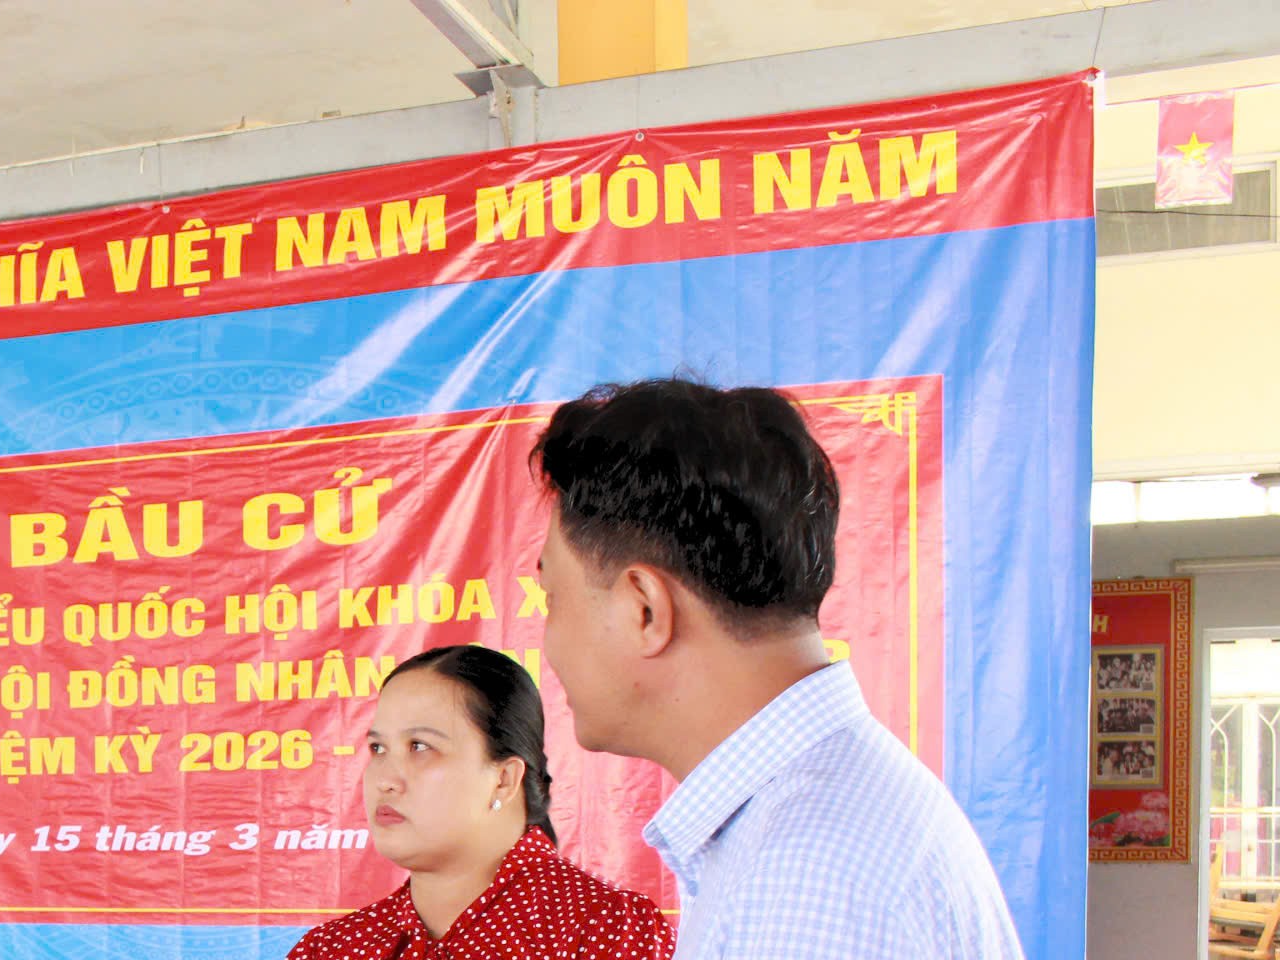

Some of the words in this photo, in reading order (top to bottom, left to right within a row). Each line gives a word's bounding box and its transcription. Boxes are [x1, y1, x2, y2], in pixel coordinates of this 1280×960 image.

[106, 218, 253, 297] VIỆT
[275, 194, 447, 272] NAM
[475, 154, 721, 243] MUÔN
[752, 128, 958, 215] NĂM
[10, 486, 204, 568] BẦU
[242, 466, 394, 551] CỬ
[62, 585, 206, 648] QUỐC
[224, 583, 318, 641] HỘI
[338, 573, 497, 629] KHÓA
[66, 655, 216, 709] ĐỒNG
[235, 649, 397, 703] NHÂN
[94, 726, 161, 775] KỲ
[179, 729, 314, 772] 2026
[31, 825, 82, 852] 15
[95, 824, 216, 856] tháng
[229, 823, 259, 850] 3
[274, 823, 369, 850] năm
